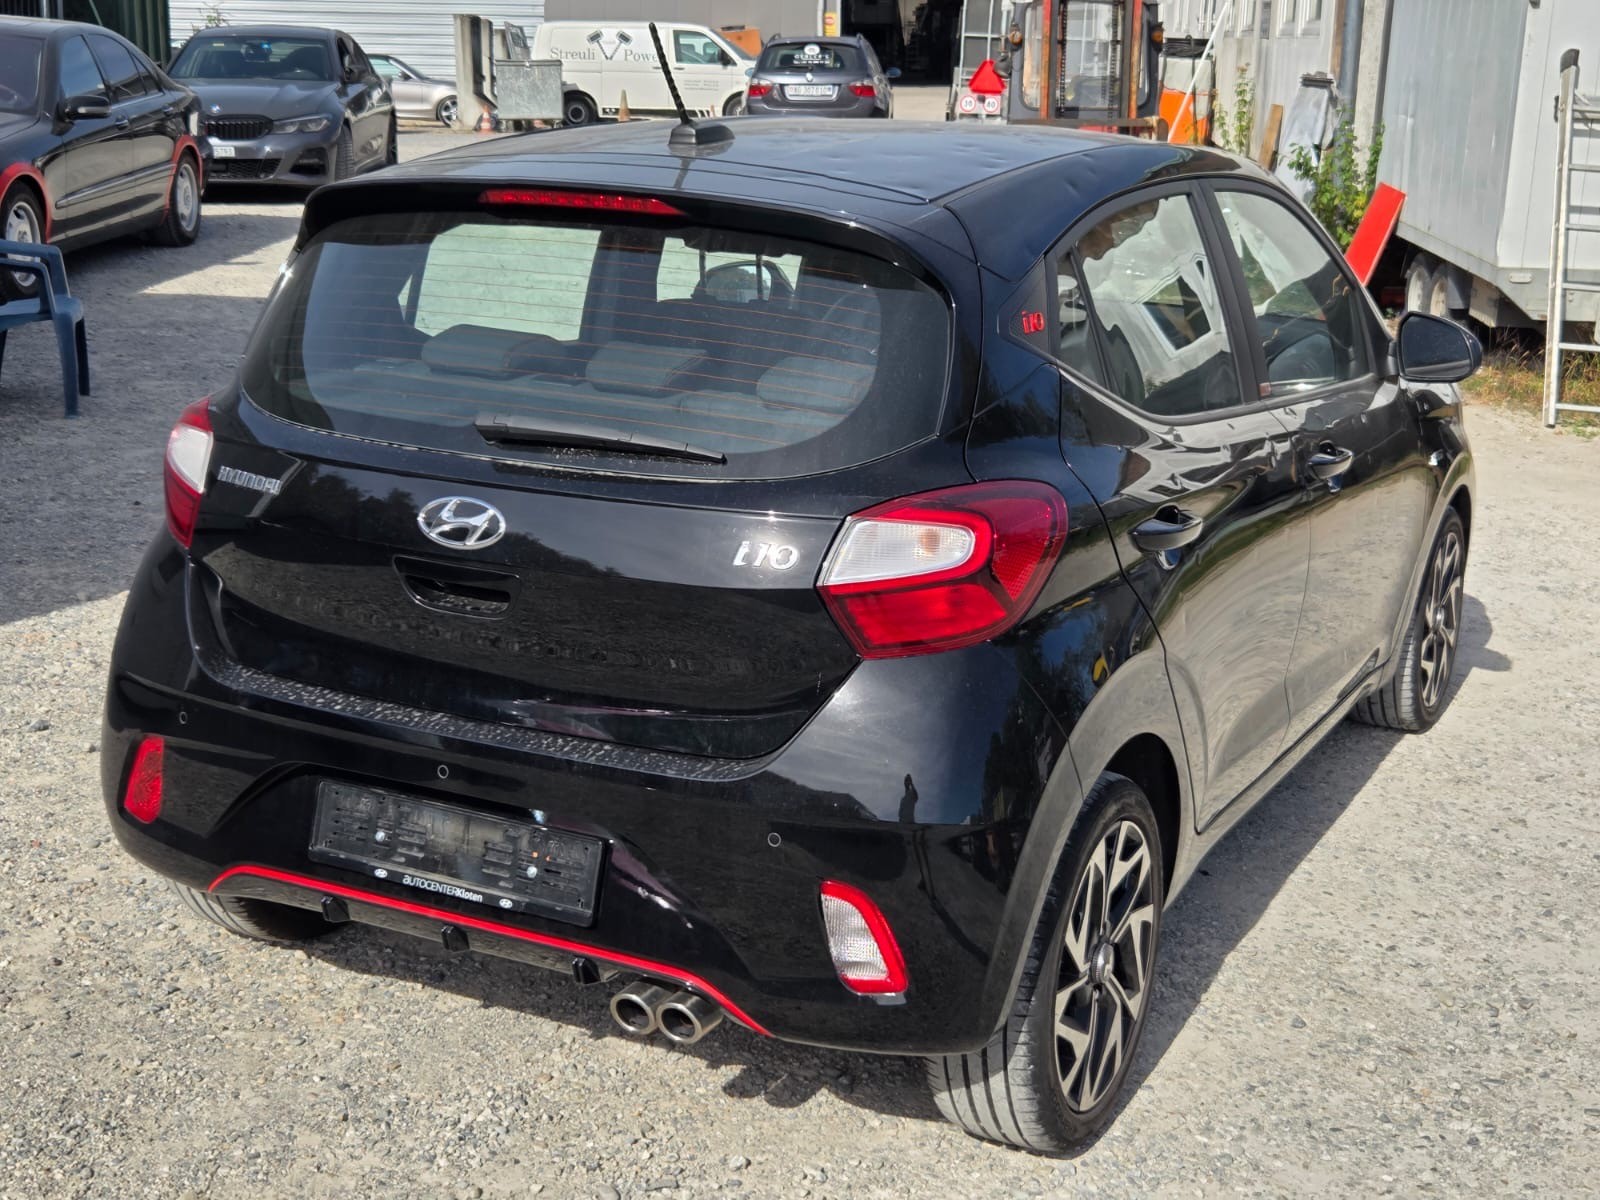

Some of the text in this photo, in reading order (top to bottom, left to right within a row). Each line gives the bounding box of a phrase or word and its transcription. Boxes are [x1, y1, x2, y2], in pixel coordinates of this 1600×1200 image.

[550, 47, 660, 62] Streuli Powe
[1021, 310, 1045, 334] i10
[217, 465, 281, 496] HYUNDAI
[732, 541, 799, 570] i10
